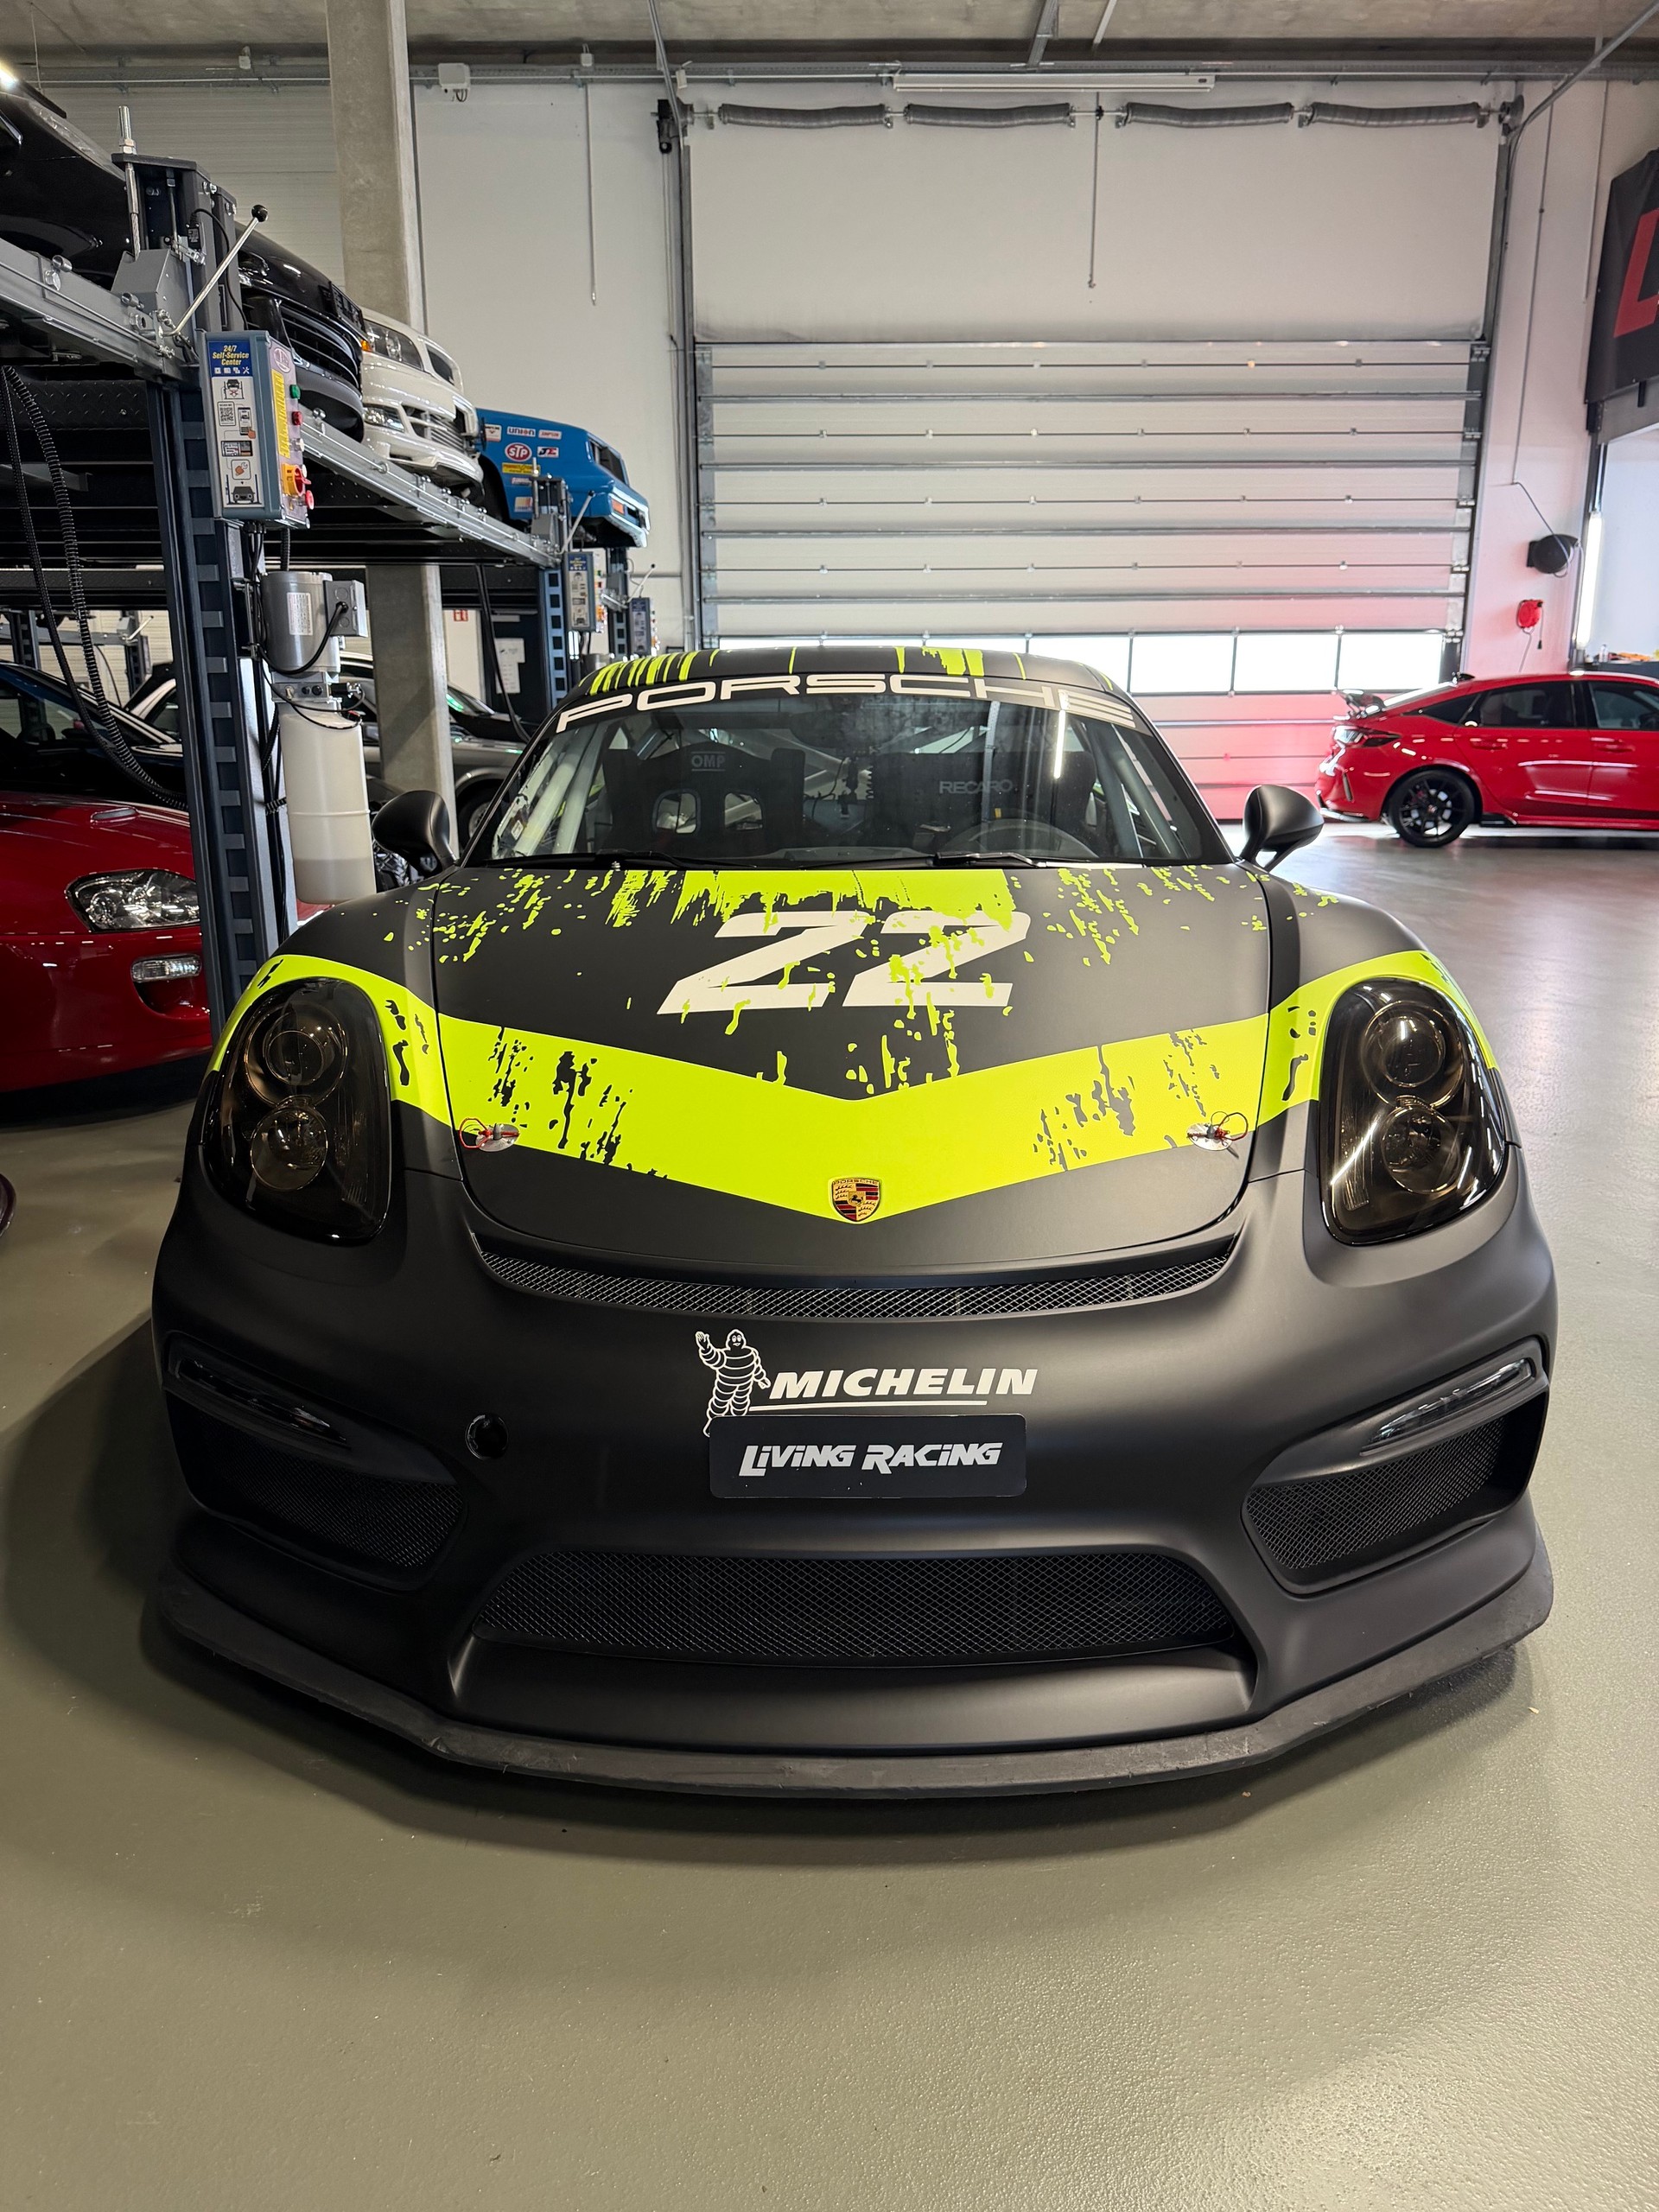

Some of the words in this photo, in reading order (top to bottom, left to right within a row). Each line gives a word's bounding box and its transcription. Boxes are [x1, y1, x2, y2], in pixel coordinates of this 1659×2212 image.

[508, 445, 529, 458] STP
[556, 672, 1136, 734] PORSCHE
[691, 754, 725, 768] OMP
[938, 779, 1014, 794] RECARO
[657, 911, 1031, 1014] 22
[769, 1369, 1038, 1400] MICHELIN
